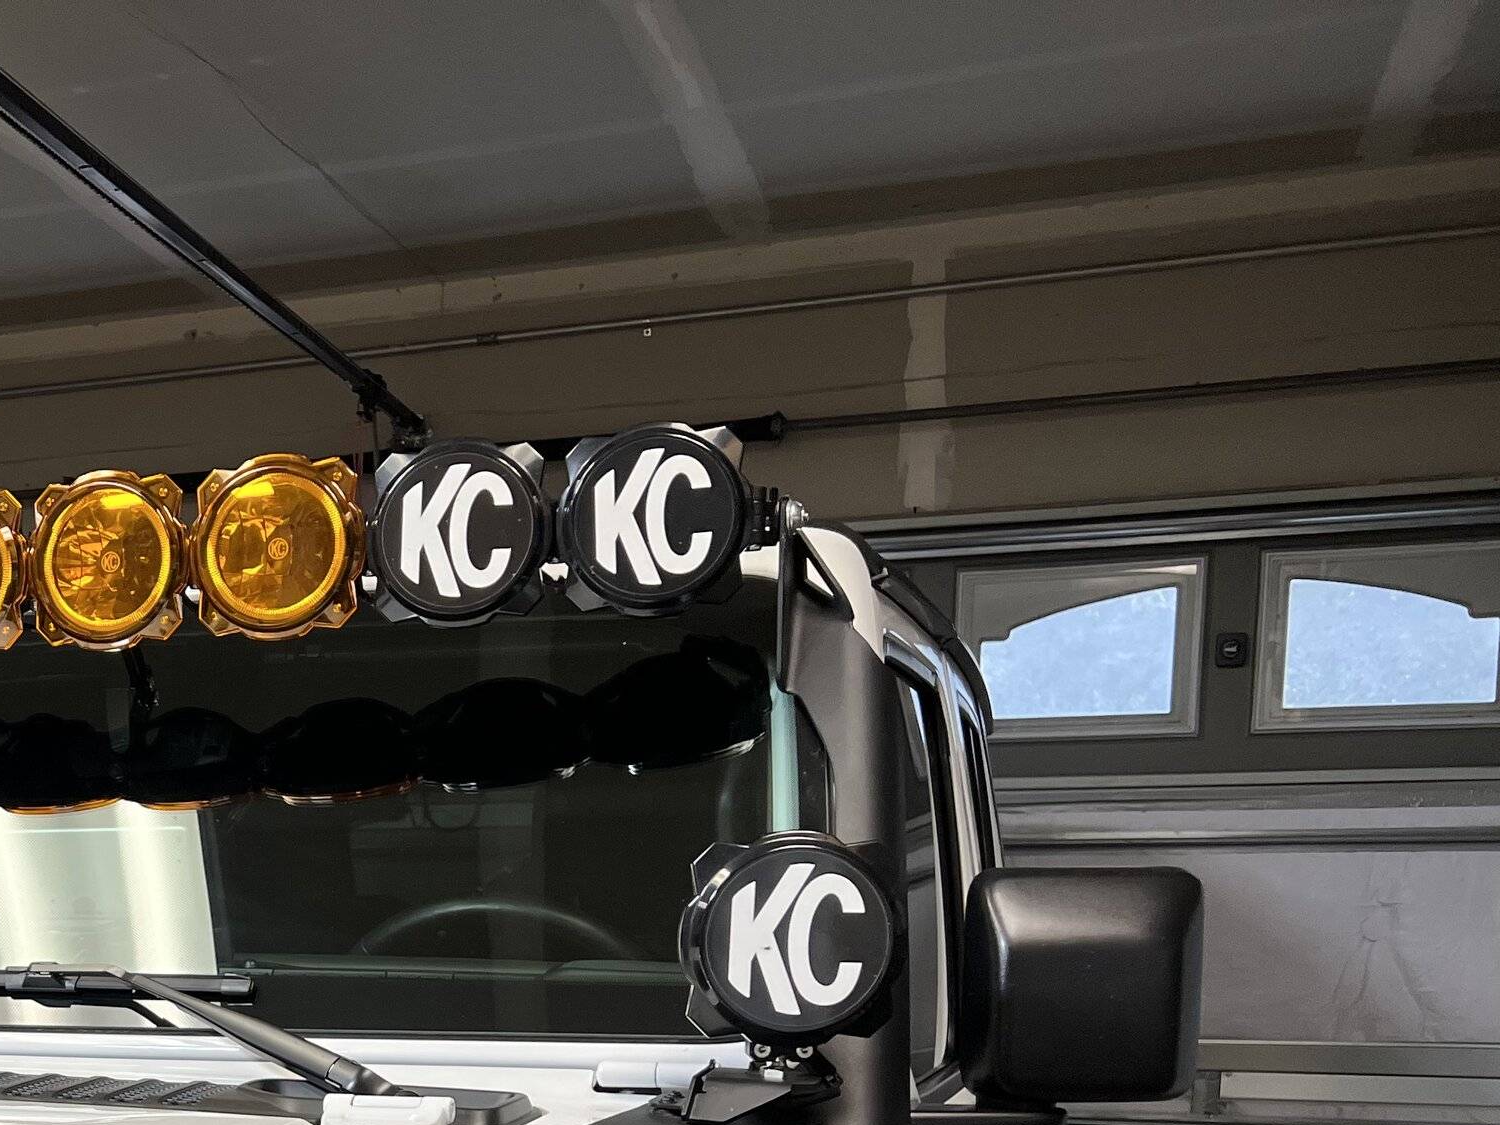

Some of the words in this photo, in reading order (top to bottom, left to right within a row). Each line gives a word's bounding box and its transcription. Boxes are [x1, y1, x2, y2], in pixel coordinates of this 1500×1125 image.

[102, 553, 118, 571] KC
[269, 540, 286, 558] KC
[401, 464, 514, 598] KC
[593, 448, 713, 586] KC
[728, 863, 866, 1016] KC
